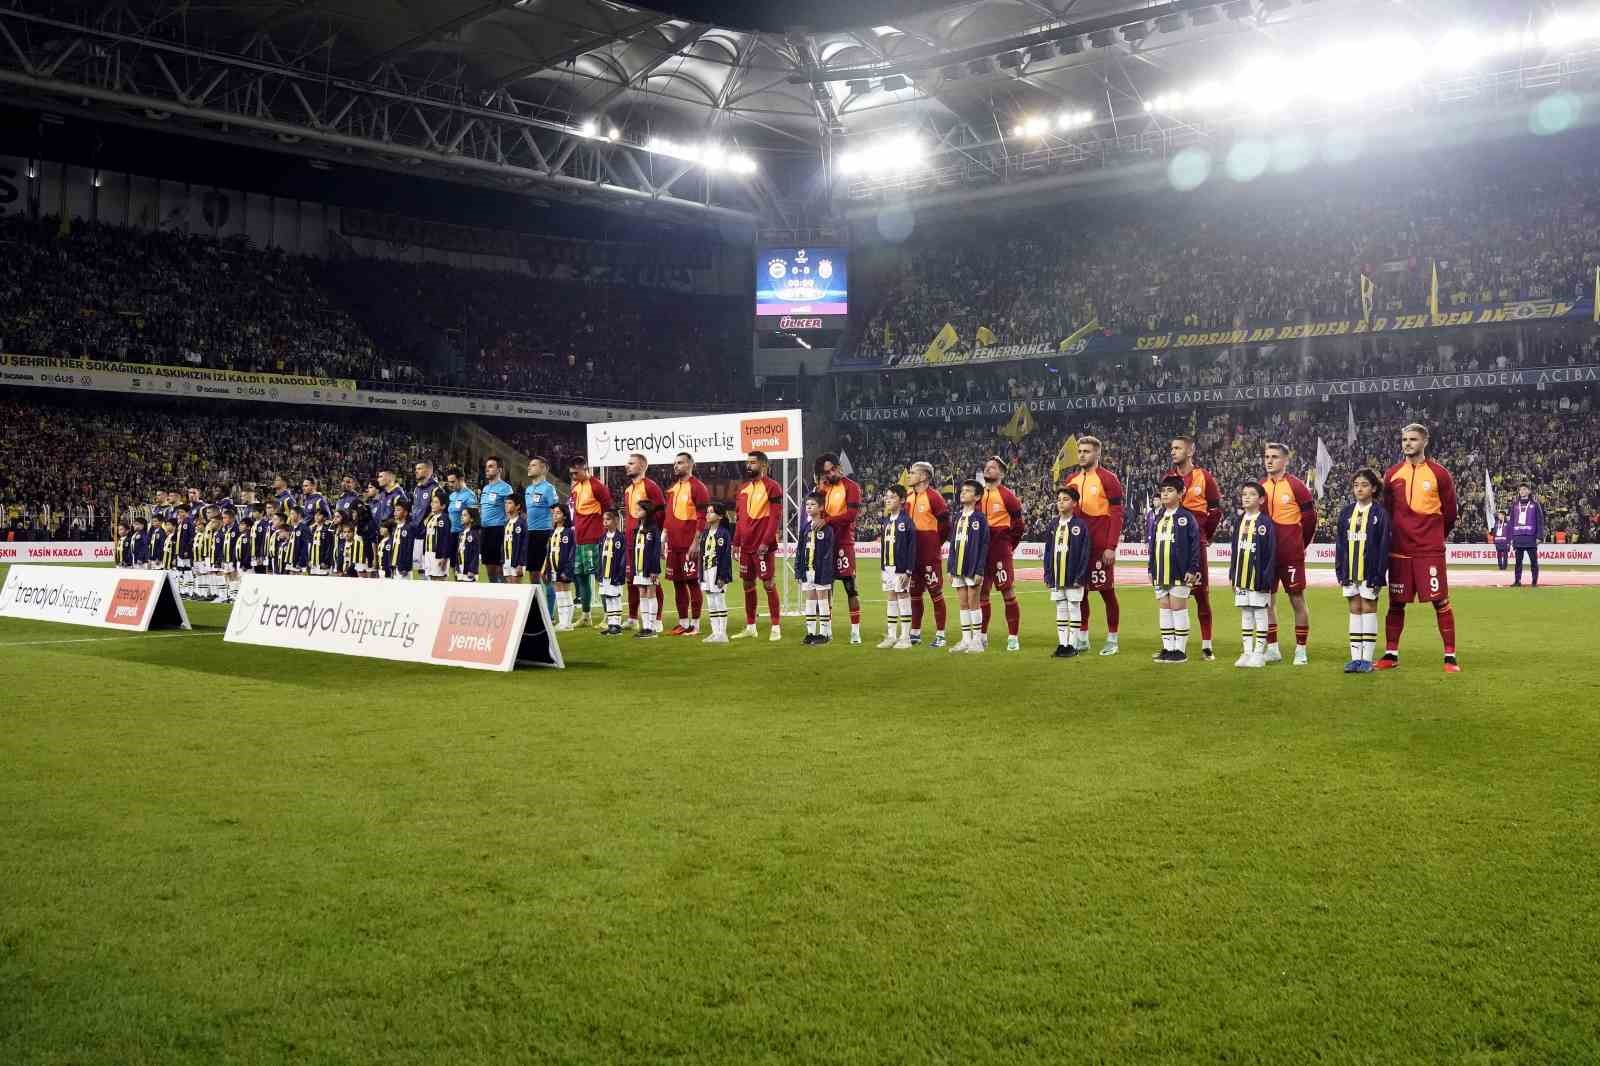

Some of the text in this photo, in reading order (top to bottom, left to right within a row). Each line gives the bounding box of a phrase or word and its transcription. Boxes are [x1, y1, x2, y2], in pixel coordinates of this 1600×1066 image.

[779, 315, 822, 329] ÜLKER
[61, 358, 84, 369] HER
[85, 360, 154, 374] SOKAĞINDA
[268, 375, 318, 386] ANADOLU
[918, 406, 981, 417] ACIBADEM
[1066, 395, 1136, 409] ACIBADEM
[1148, 392, 1223, 405] ACIBADEM
[1234, 385, 1316, 400] ACIBADEM
[1328, 380, 1415, 393] ACIBADEM
[1431, 373, 1524, 388] ACIBADEM
[745, 423, 785, 437] trendyol
[614, 431, 734, 453] trendyol SüperLig
[750, 437, 780, 449] yemek
[29, 546, 50, 557] YASİN
[53, 549, 83, 557] KARACA
[1451, 550, 1481, 559] MEHMET
[683, 561, 696, 572] 42
[760, 560, 767, 572] 8
[995, 569, 1008, 583] 10
[1091, 570, 1106, 583] 53
[1288, 568, 1297, 583] 7
[1430, 577, 1439, 592] 9
[15, 582, 62, 608] trendyol
[260, 598, 420, 649] trendyol SüperLig
[448, 606, 511, 629] trendyol
[447, 632, 495, 652] yemek
